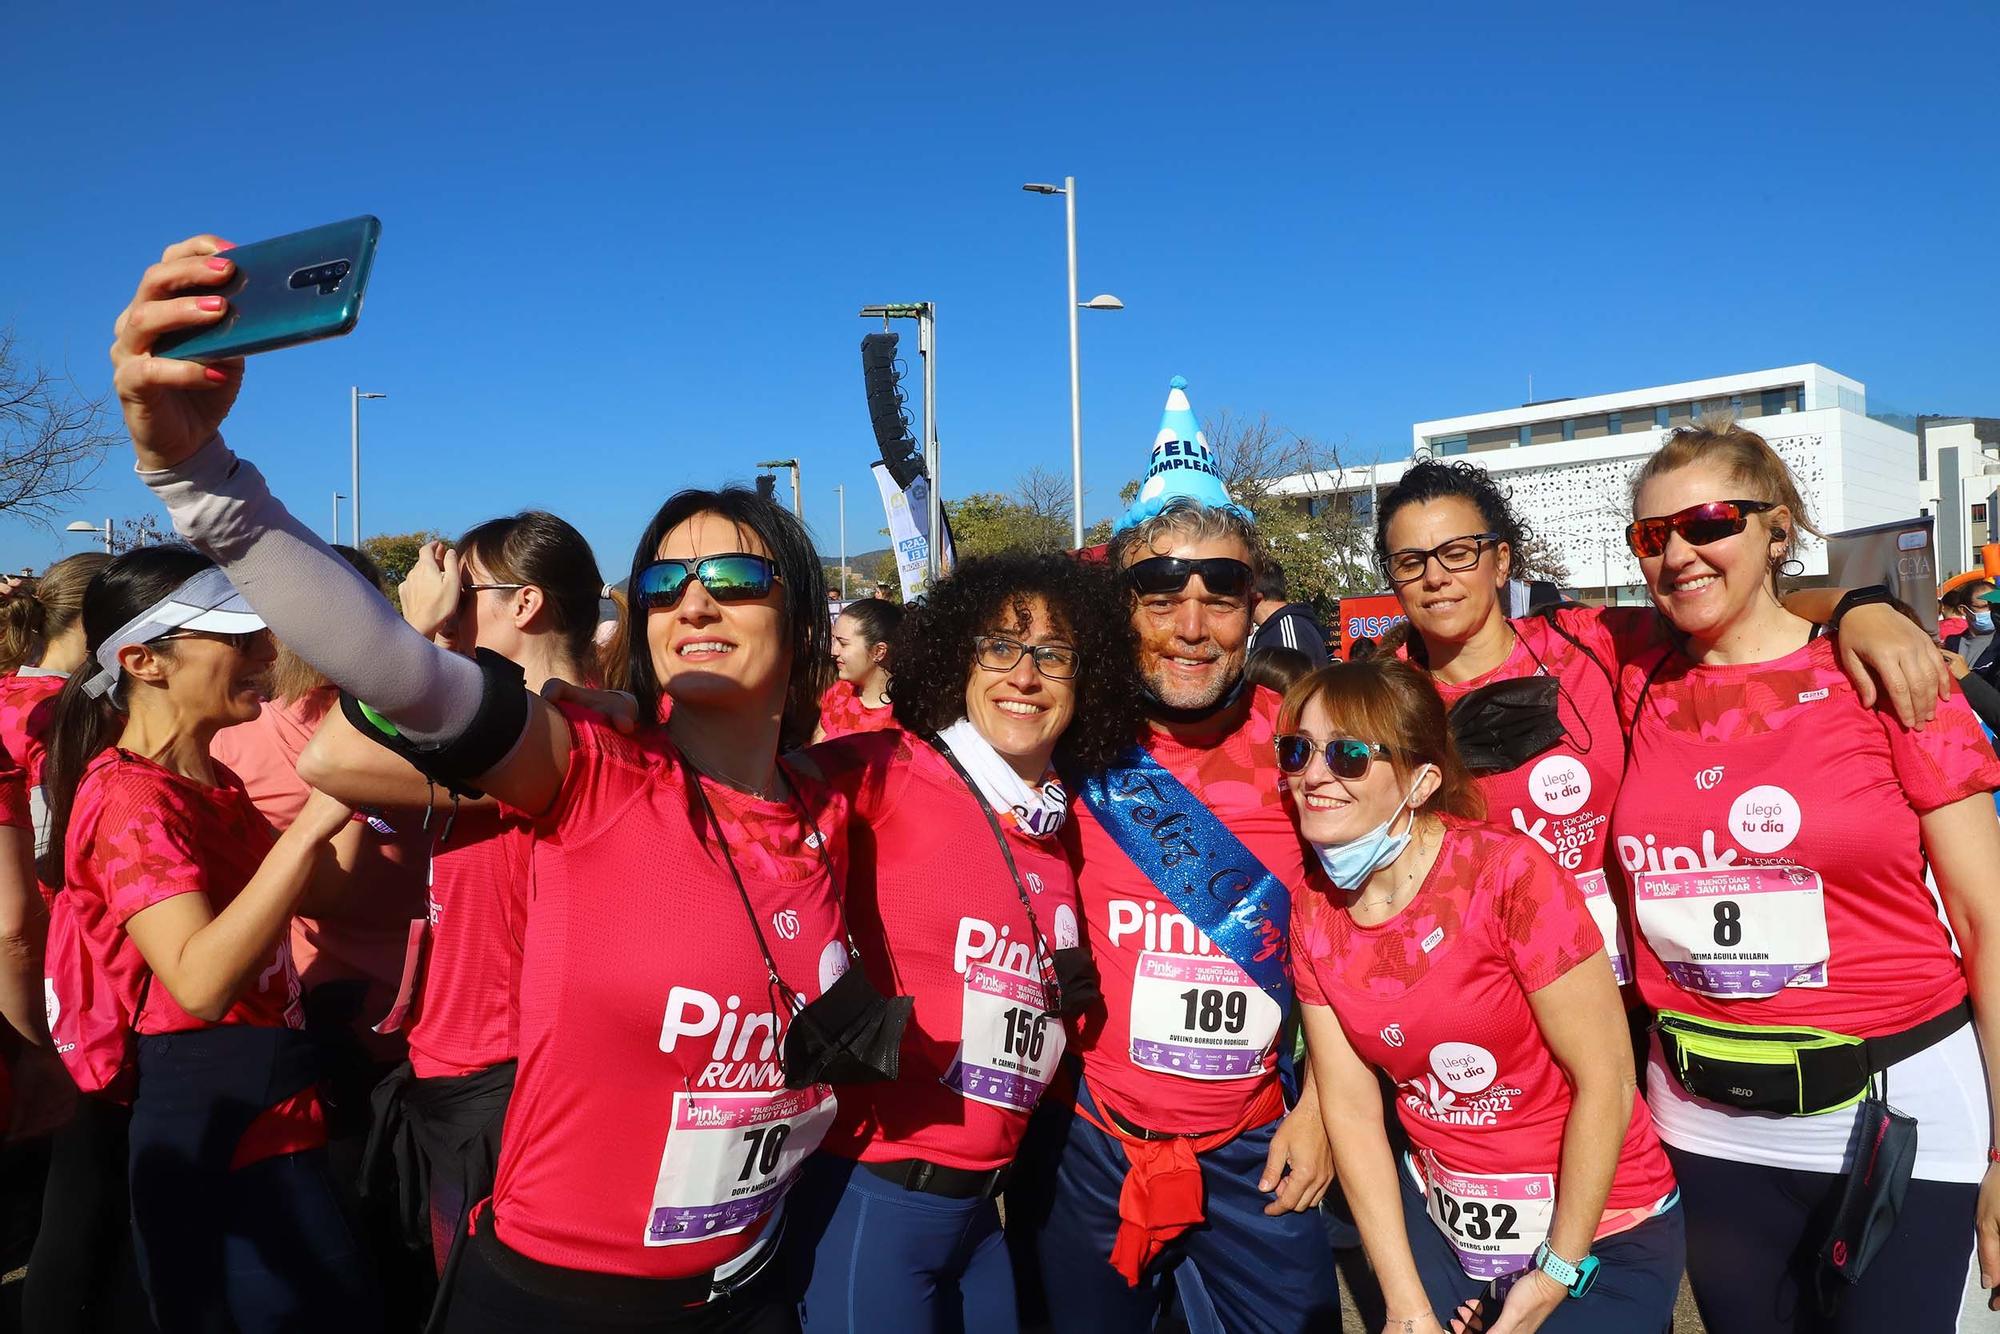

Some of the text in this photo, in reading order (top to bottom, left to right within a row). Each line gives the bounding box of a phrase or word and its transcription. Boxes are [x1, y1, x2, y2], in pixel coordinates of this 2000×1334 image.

[1144, 459, 1222, 484] CUMPLEAÑ
[1542, 769, 1576, 788] Llegó
[1544, 783, 1582, 802] tu día
[1745, 802, 1783, 819] Llegó
[1554, 814, 1607, 838] 6 de marzo
[1741, 819, 1785, 833] tu día
[1555, 828, 1597, 852] 2022
[1645, 880, 1671, 893] Pink
[1696, 883, 1751, 894] JAVI Y MAR
[1108, 900, 1211, 954] Pin
[1713, 900, 1741, 946] 8
[1222, 975, 1239, 983] MAR
[1180, 987, 1248, 1034] 189
[659, 986, 805, 1061] Pin
[1004, 1007, 1047, 1062] 156
[1169, 1035, 1193, 1044] AVELINO
[1441, 1054, 1476, 1068] Llegó
[697, 1062, 786, 1089] RUNN
[1447, 1066, 1485, 1081] tu día
[687, 1105, 721, 1121] Pink
[749, 1111, 772, 1122] JAVI
[772, 1109, 780, 1118] Y
[780, 1104, 798, 1116] MAR
[1469, 1096, 1514, 1112] 2022
[737, 1123, 791, 1181] 70
[1466, 1189, 1488, 1197] MAR
[1433, 1186, 1520, 1240] 1232
